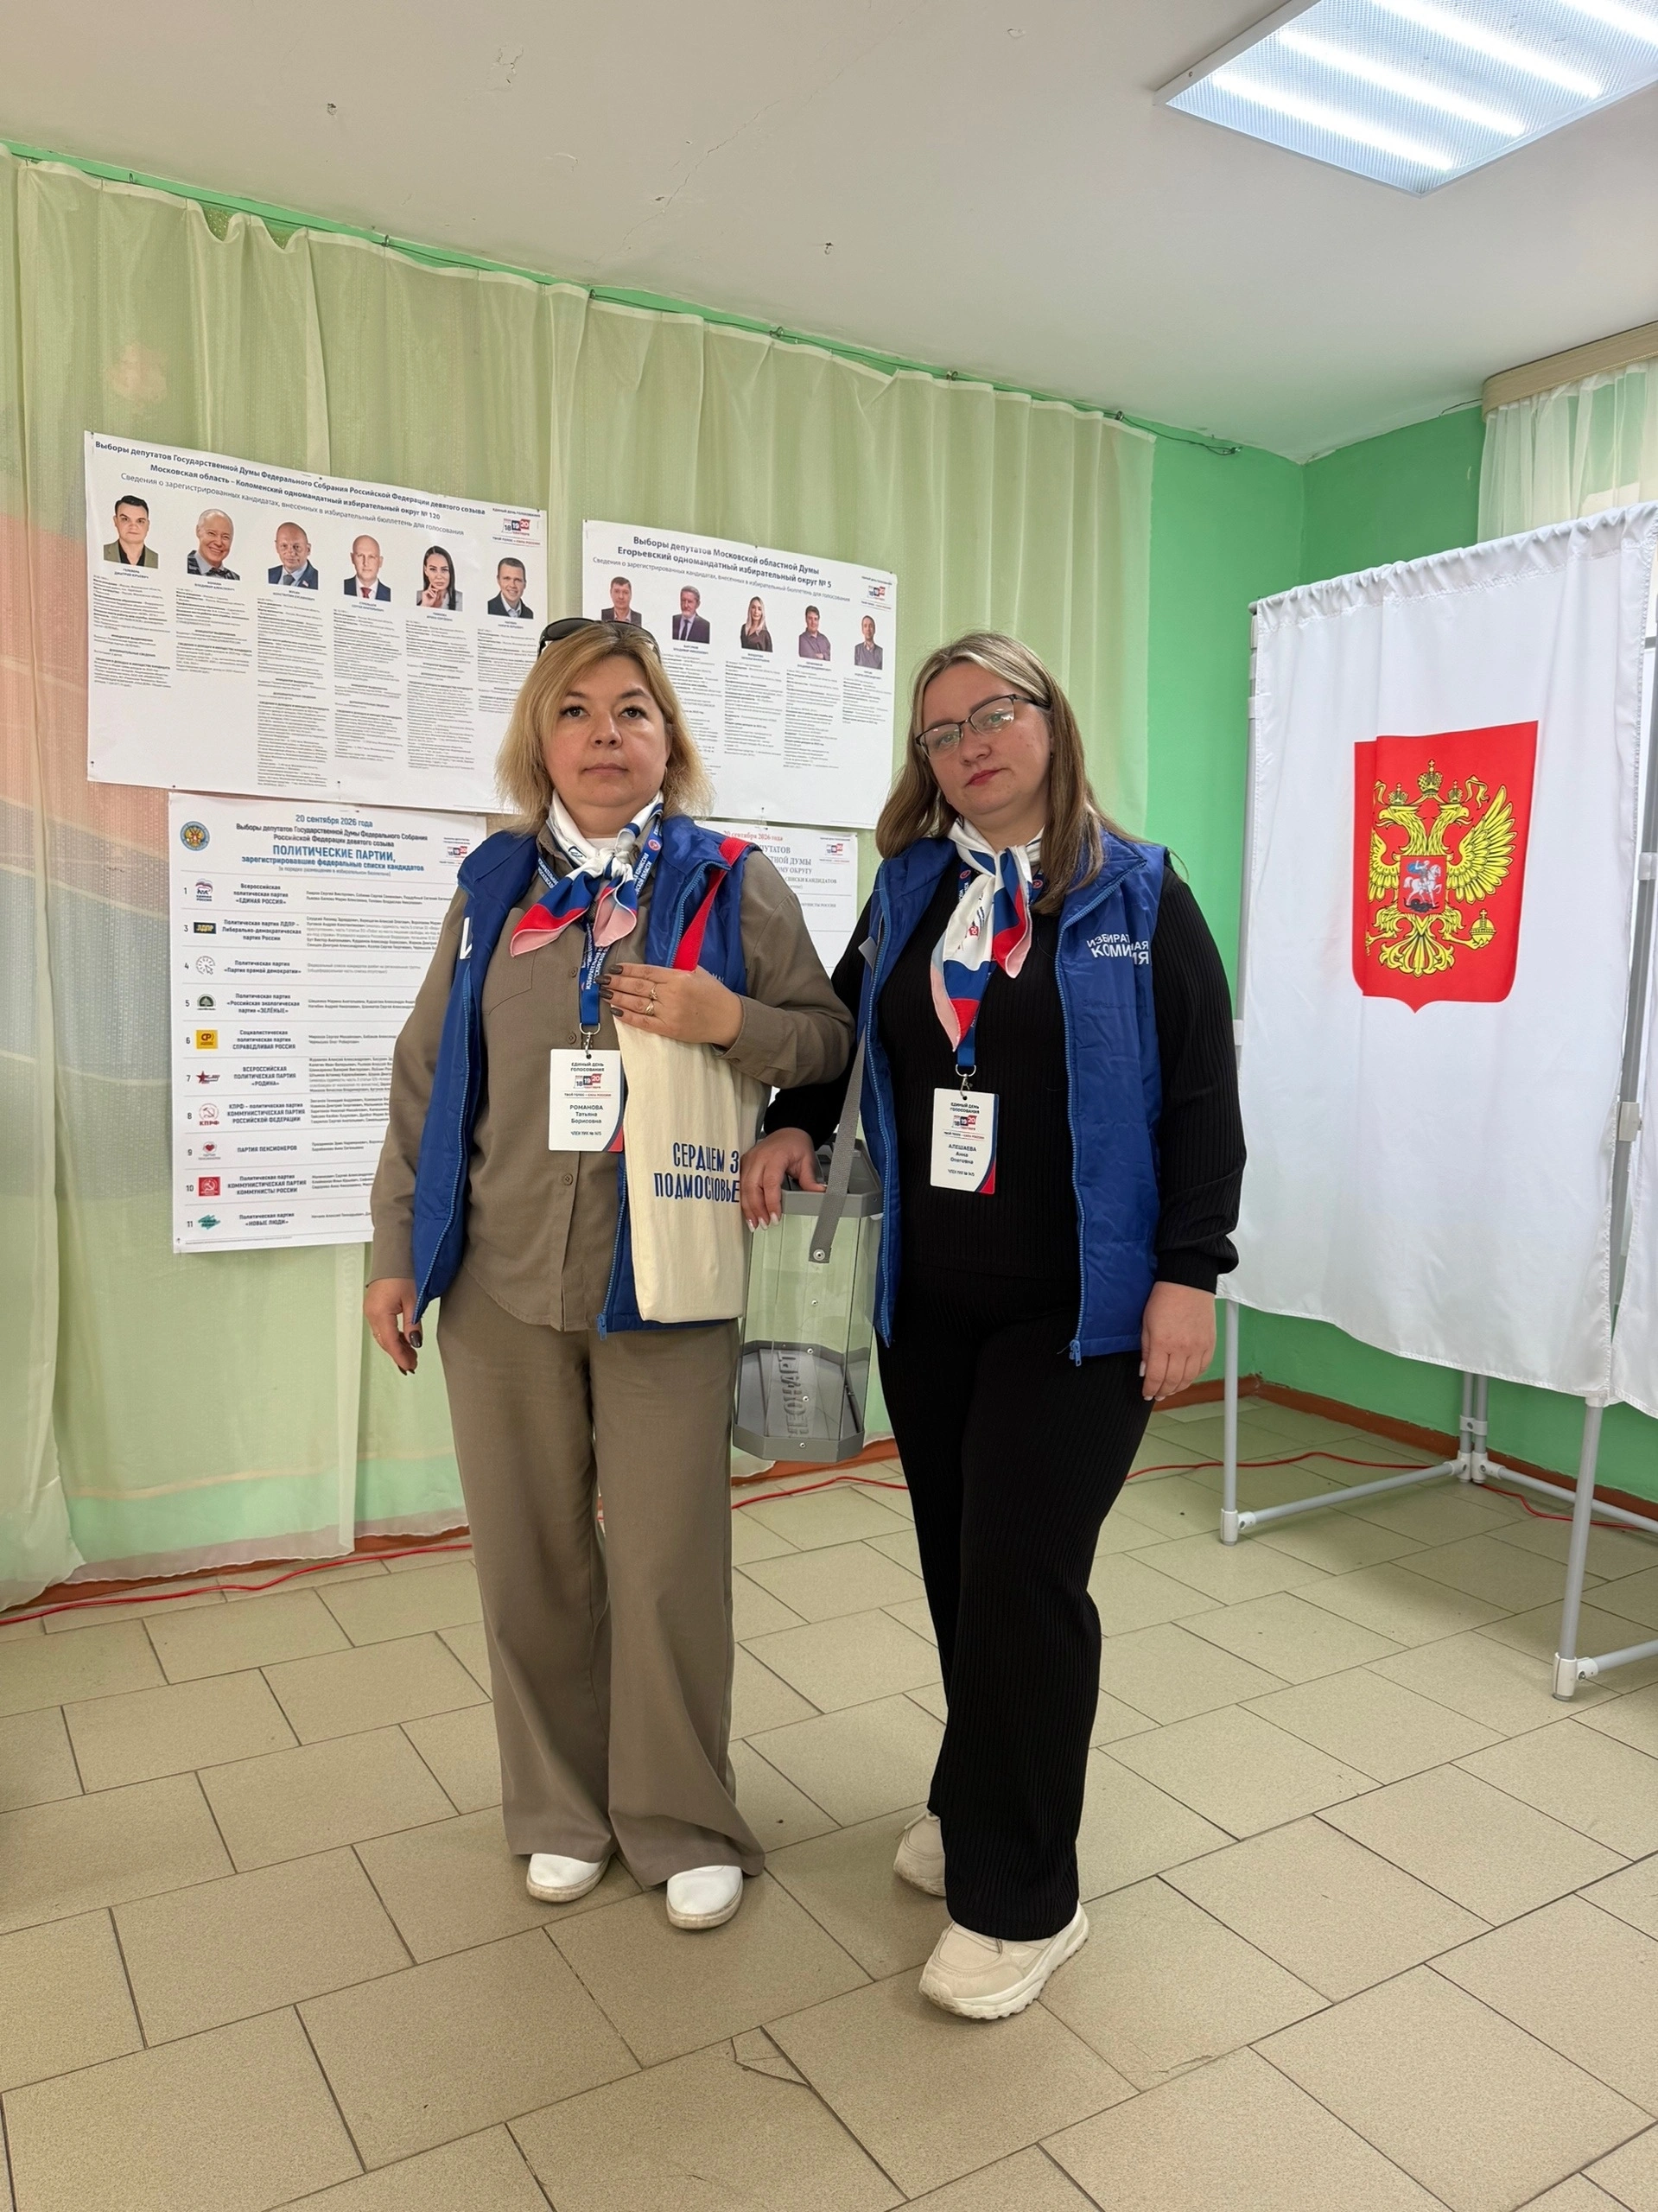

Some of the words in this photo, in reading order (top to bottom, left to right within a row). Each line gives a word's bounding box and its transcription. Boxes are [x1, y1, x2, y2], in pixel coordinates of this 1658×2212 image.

[95, 442, 129, 453] Выборы
[131, 449, 172, 460] депутатов
[173, 456, 238, 472] Государственной
[239, 467, 260, 476] Думы
[261, 473, 312, 486] Федерального
[314, 482, 348, 492] Собрания
[350, 488, 391, 498] Российской
[392, 494, 430, 505] Федерации
[431, 502, 460, 511] девятого
[150, 466, 198, 478] Московская
[199, 474, 230, 483] область
[236, 481, 283, 494] Коломенский
[284, 490, 342, 504] одномандатный
[343, 501, 400, 512] избирательный
[121, 474, 158, 484] Сведения
[166, 482, 241, 498] зарегистрированных
[281, 502, 318, 512] внесенных
[325, 510, 376, 521] избирательный
[377, 517, 412, 526] бюллетень
[426, 525, 464, 535] голосования
[618, 547, 672, 560] Егорьевский
[673, 556, 738, 571] одномандатный
[739, 567, 796, 581] избирательный
[798, 577, 817, 585] округ
[633, 537, 669, 548] Выборы
[671, 544, 712, 555] депутатов
[713, 550, 758, 563] Московской
[759, 559, 798, 571] областной
[799, 565, 819, 574] Думы
[294, 827, 343, 839] Государственной
[344, 830, 360, 840] Думы
[296, 814, 305, 822] 20
[341, 817, 357, 826] 2026
[242, 857, 316, 865] зарегистрировавшие
[273, 845, 353, 858] ПОЛИТИЧЕСКИЕ
[356, 850, 395, 863] ПАРТИИ,
[760, 845, 790, 854] ПУТАТОВ
[673, 1142, 724, 1172] СЕРДЦЕМ
[730, 1150, 739, 1173] З
